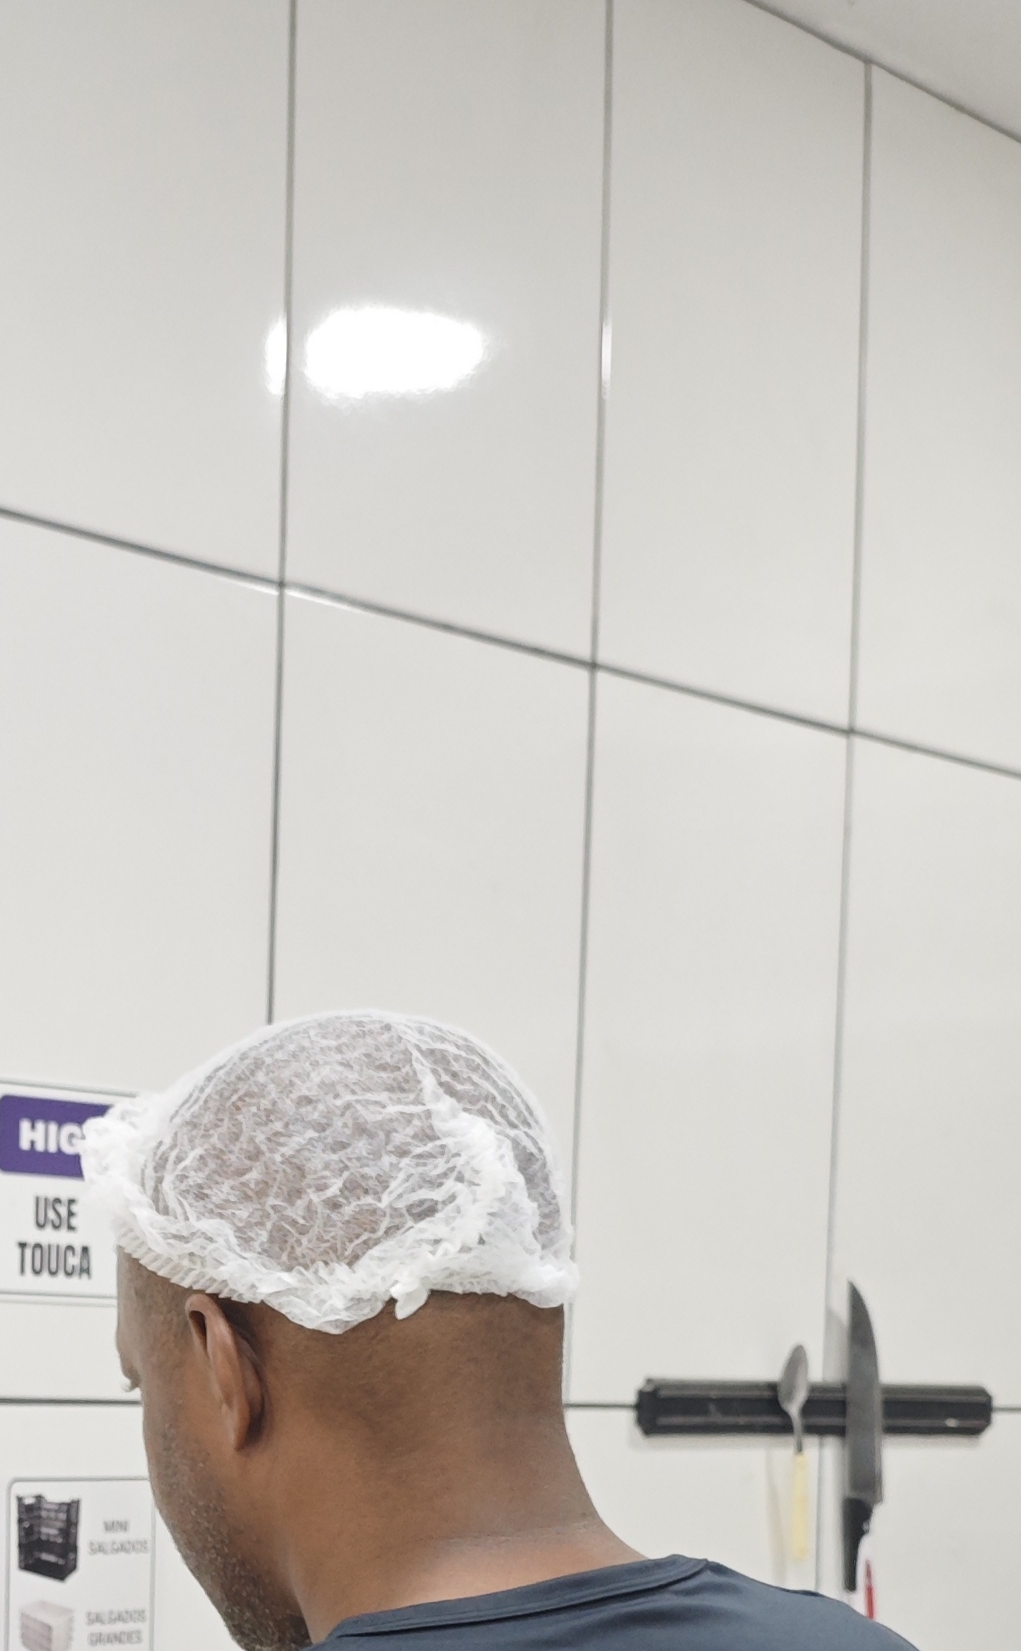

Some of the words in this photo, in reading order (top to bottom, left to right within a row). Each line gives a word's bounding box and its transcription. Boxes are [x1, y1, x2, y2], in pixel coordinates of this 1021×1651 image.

[18, 1117, 83, 1155] HIG
[34, 1195, 77, 1231] USE
[17, 1241, 91, 1279] TOUCA
